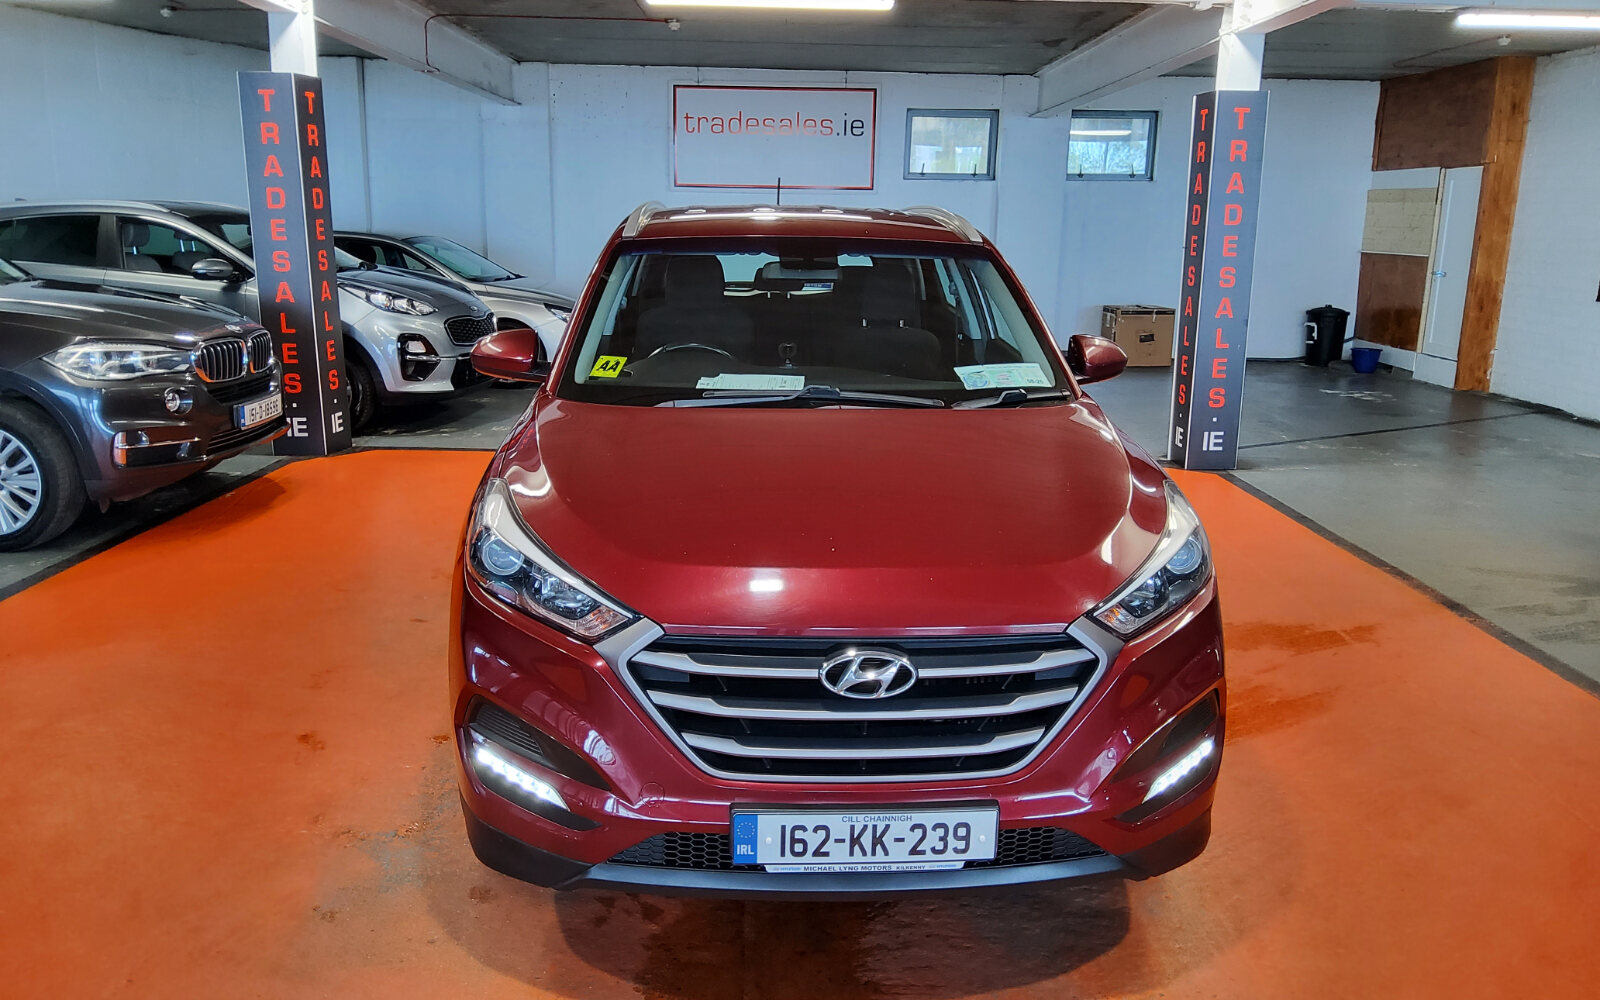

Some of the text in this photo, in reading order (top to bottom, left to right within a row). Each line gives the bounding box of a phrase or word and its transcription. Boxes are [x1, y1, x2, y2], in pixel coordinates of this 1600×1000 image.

[683, 110, 865, 137] tradesales.ie
[596, 360, 620, 372] AA
[841, 814, 913, 823] CILL CHAINNIGH
[780, 821, 971, 858] 162-KK-239
[736, 844, 755, 855] IRL
